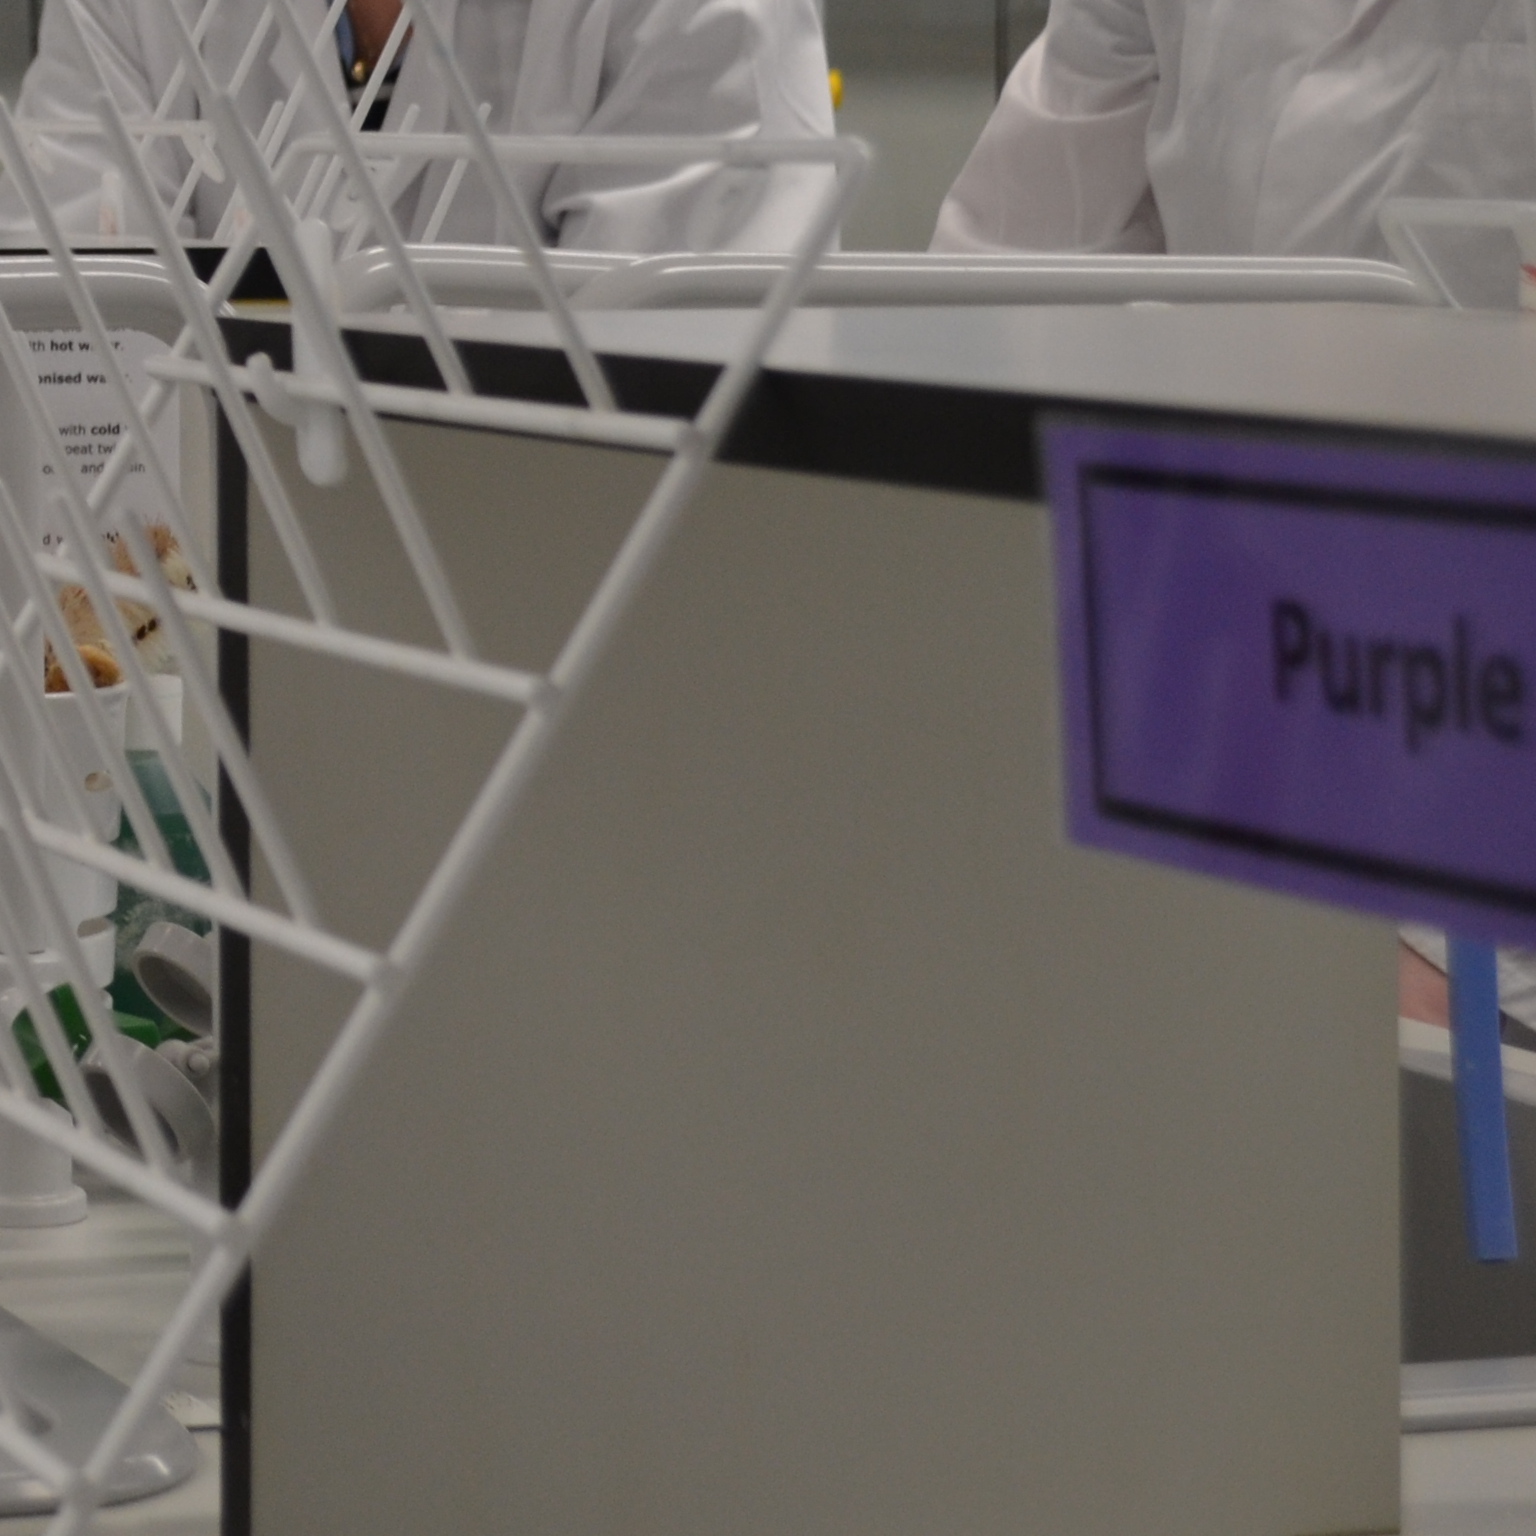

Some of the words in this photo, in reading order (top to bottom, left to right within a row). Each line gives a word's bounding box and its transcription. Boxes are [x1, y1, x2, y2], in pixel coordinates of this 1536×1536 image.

[50, 340, 74, 351] hot
[59, 423, 86, 436] with
[90, 423, 120, 435] cold
[1270, 595, 1527, 755] Purple
